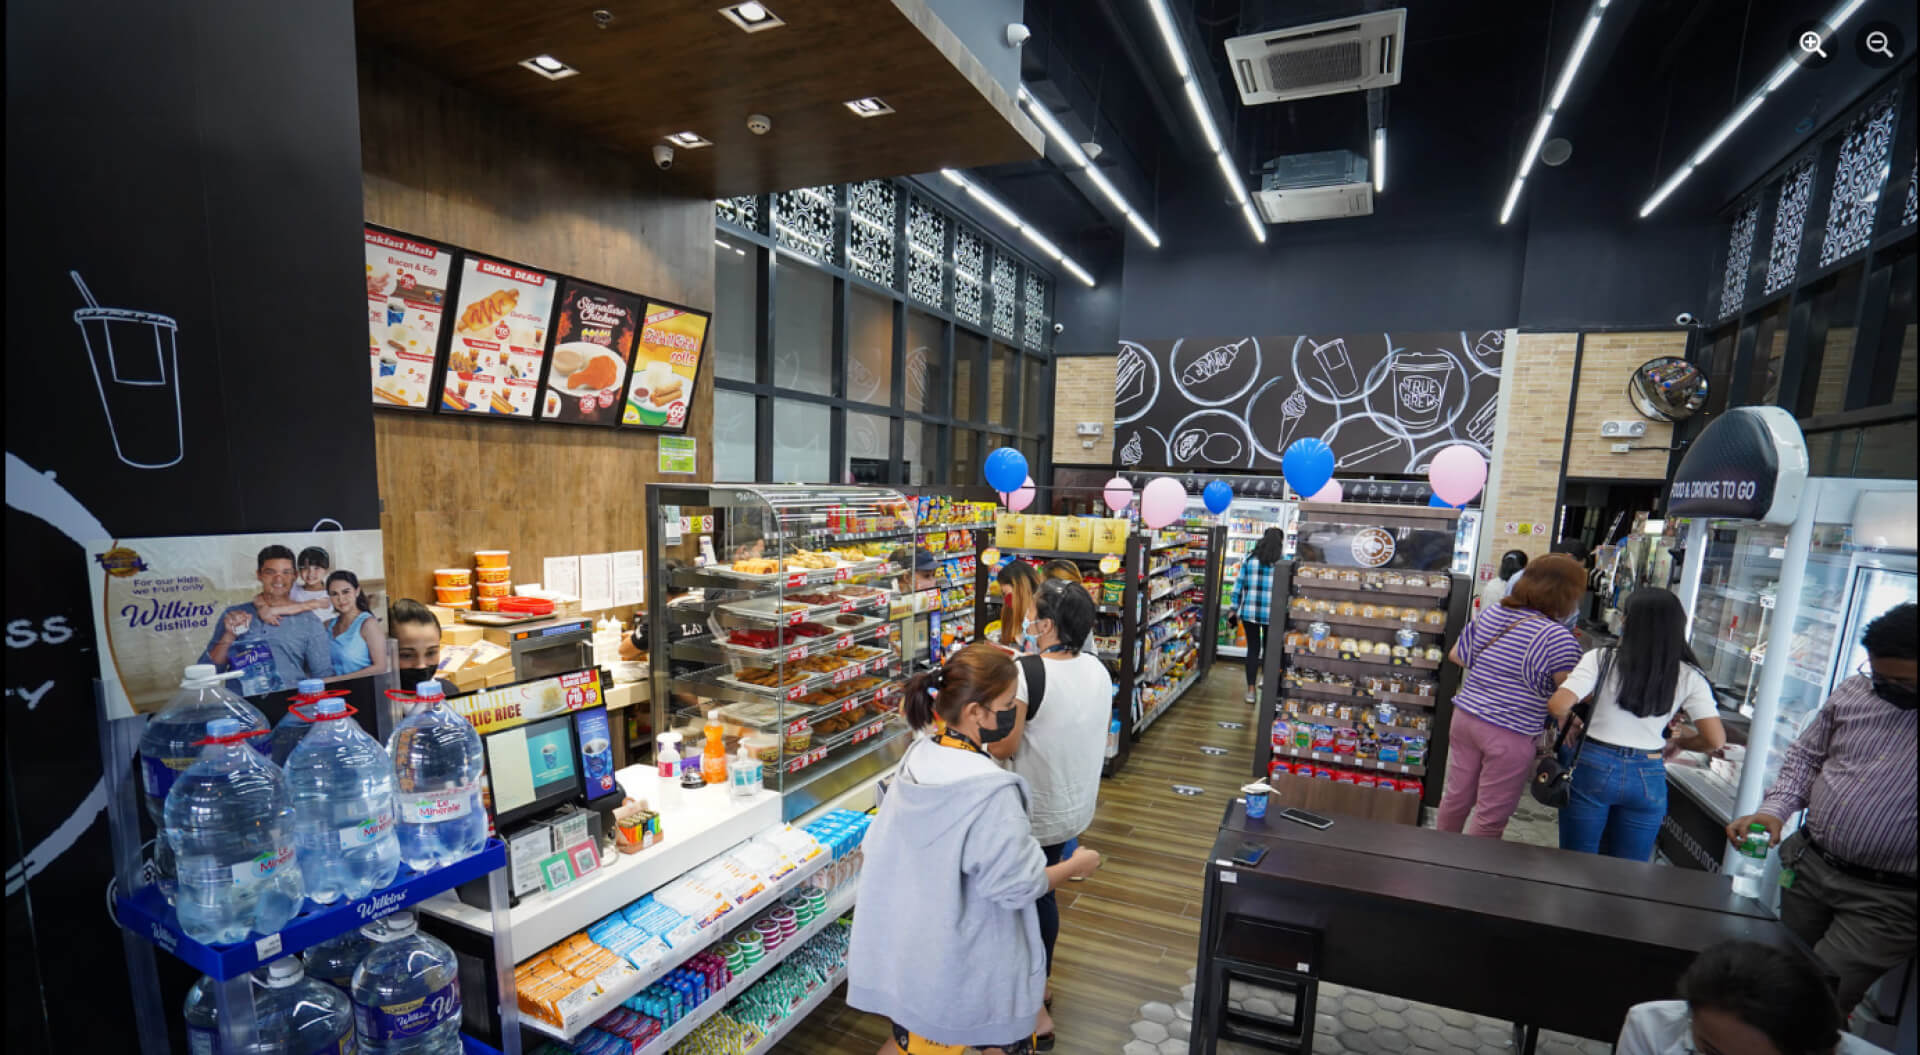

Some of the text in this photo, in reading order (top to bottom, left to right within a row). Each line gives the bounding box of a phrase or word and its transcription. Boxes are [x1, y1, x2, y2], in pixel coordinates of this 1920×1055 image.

[406, 242, 434, 257] Meals
[387, 256, 438, 277] Bacon & Egg
[482, 262, 542, 284] SNACK DEALS
[576, 296, 626, 316] Signature
[580, 310, 620, 326] Chicken
[1407, 378, 1437, 393] TRUE
[1691, 481, 1720, 498] DRINKS
[1722, 481, 1736, 499] TO
[1737, 481, 1756, 500] GO
[133, 579, 152, 587] For
[155, 578, 173, 586] our
[152, 585, 180, 594] trust
[182, 583, 204, 592] only
[121, 598, 214, 628] Wilkins
[154, 617, 208, 632] distilled
[494, 703, 522, 722] RICE
[418, 803, 461, 817] Minerale
[436, 799, 449, 808] Le
[357, 889, 407, 918] Wilkins
